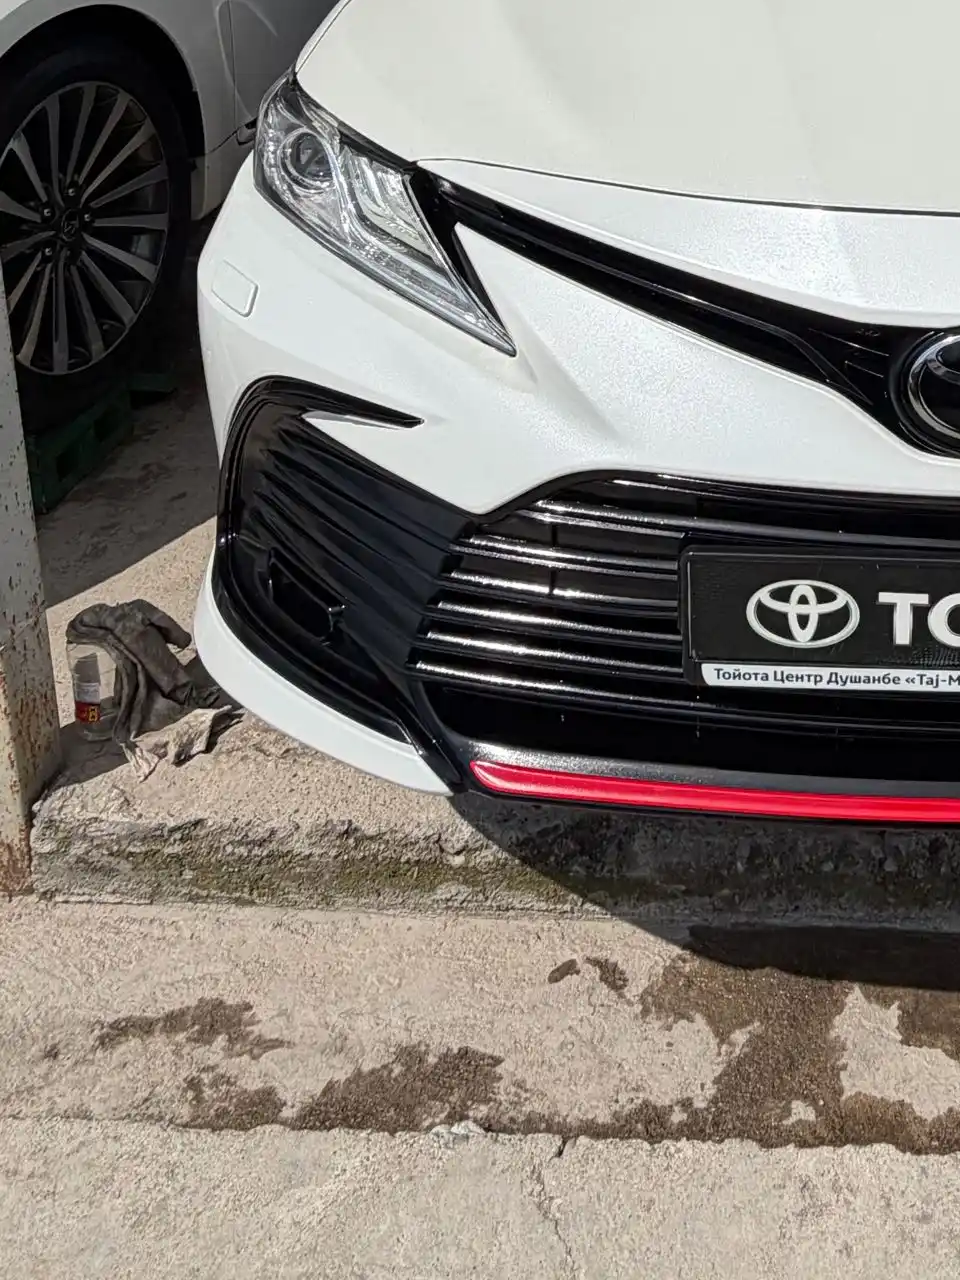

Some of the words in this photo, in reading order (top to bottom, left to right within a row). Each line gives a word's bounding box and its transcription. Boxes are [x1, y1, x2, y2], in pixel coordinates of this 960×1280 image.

[713, 667, 769, 682] Тойота
[773, 670, 824, 686] Центр
[826, 671, 901, 687] Душанбе
